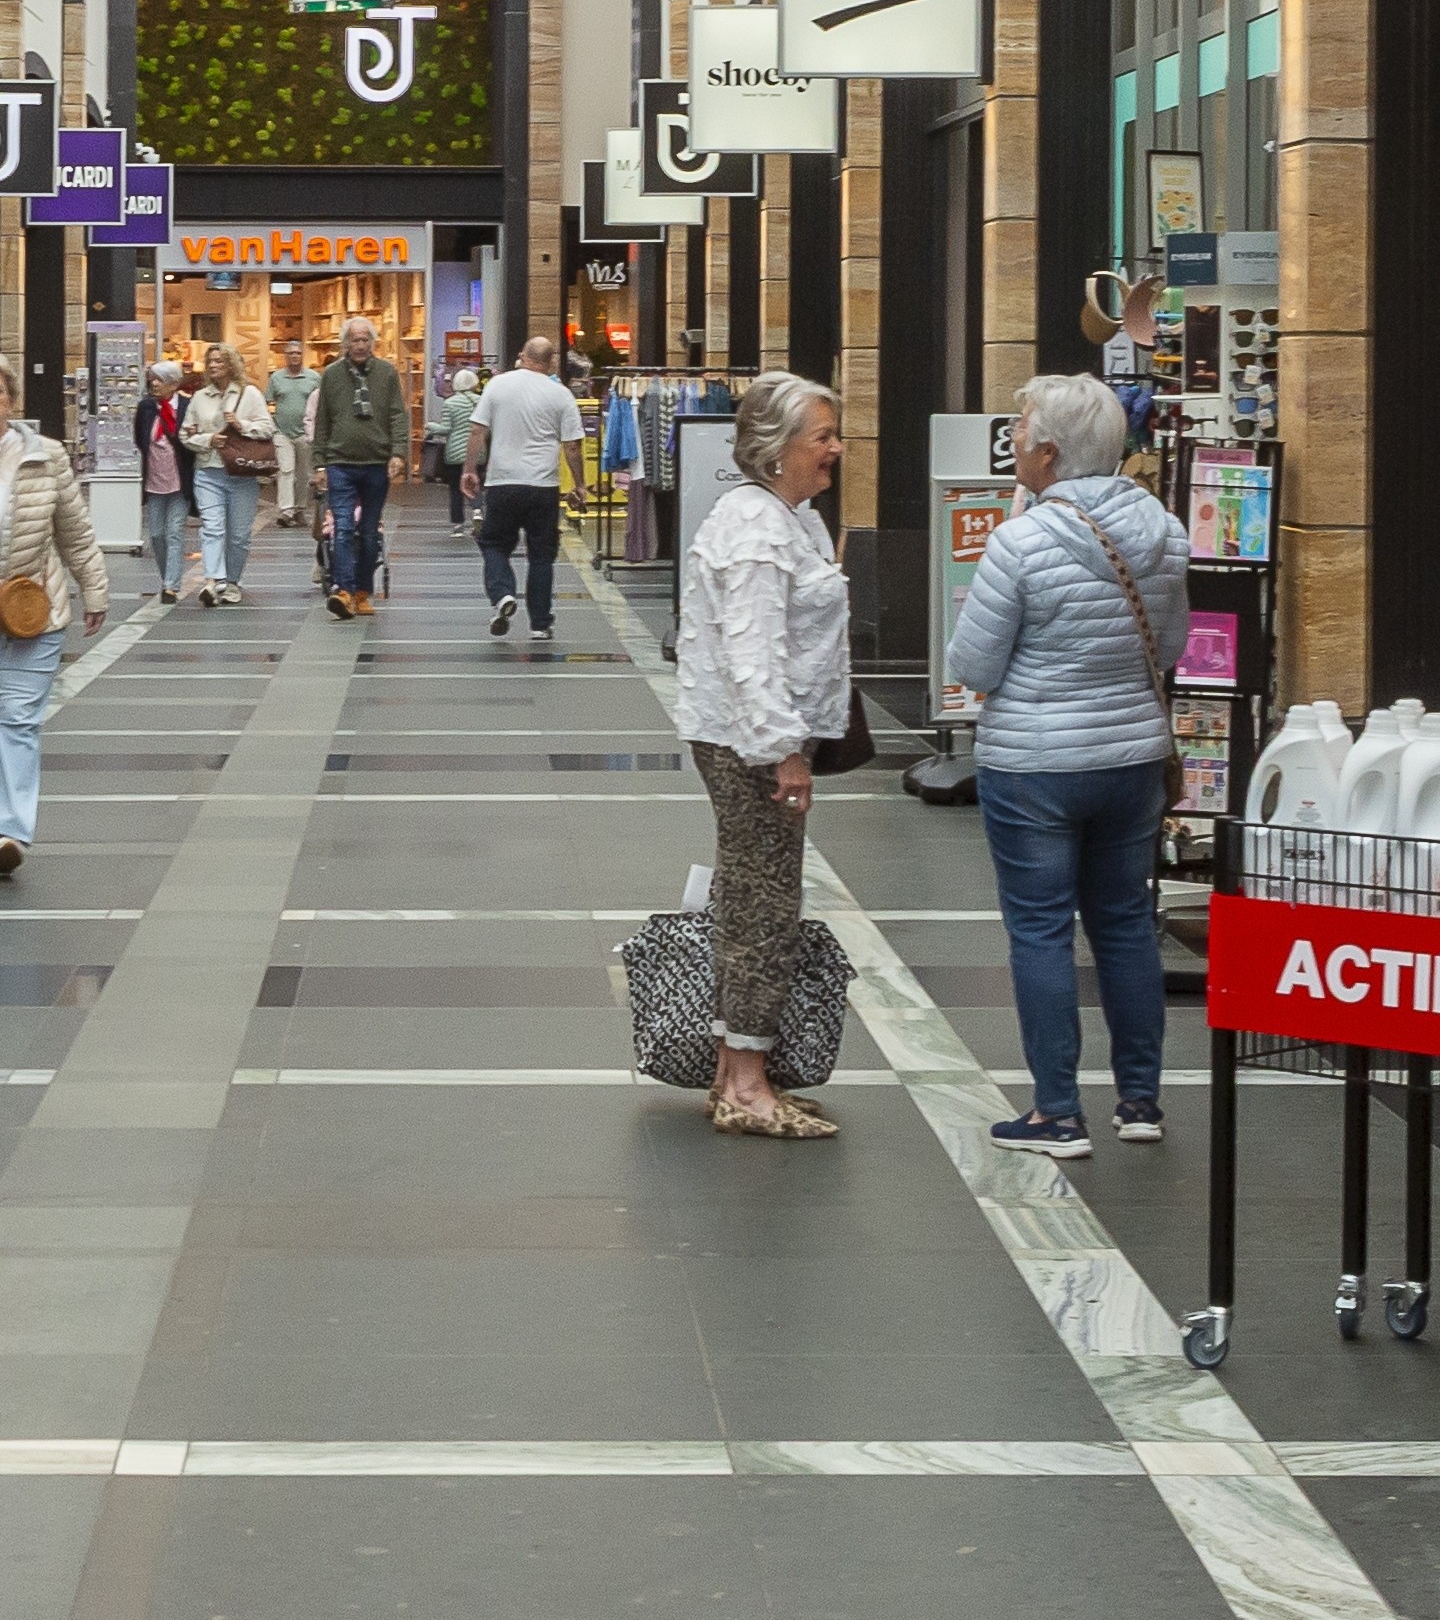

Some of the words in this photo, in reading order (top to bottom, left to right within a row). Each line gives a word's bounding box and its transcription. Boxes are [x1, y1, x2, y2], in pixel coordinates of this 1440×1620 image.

[55, 166, 113, 188] CARDI
[181, 230, 410, 264] vanHaren
[961, 513, 994, 532] 1+1
